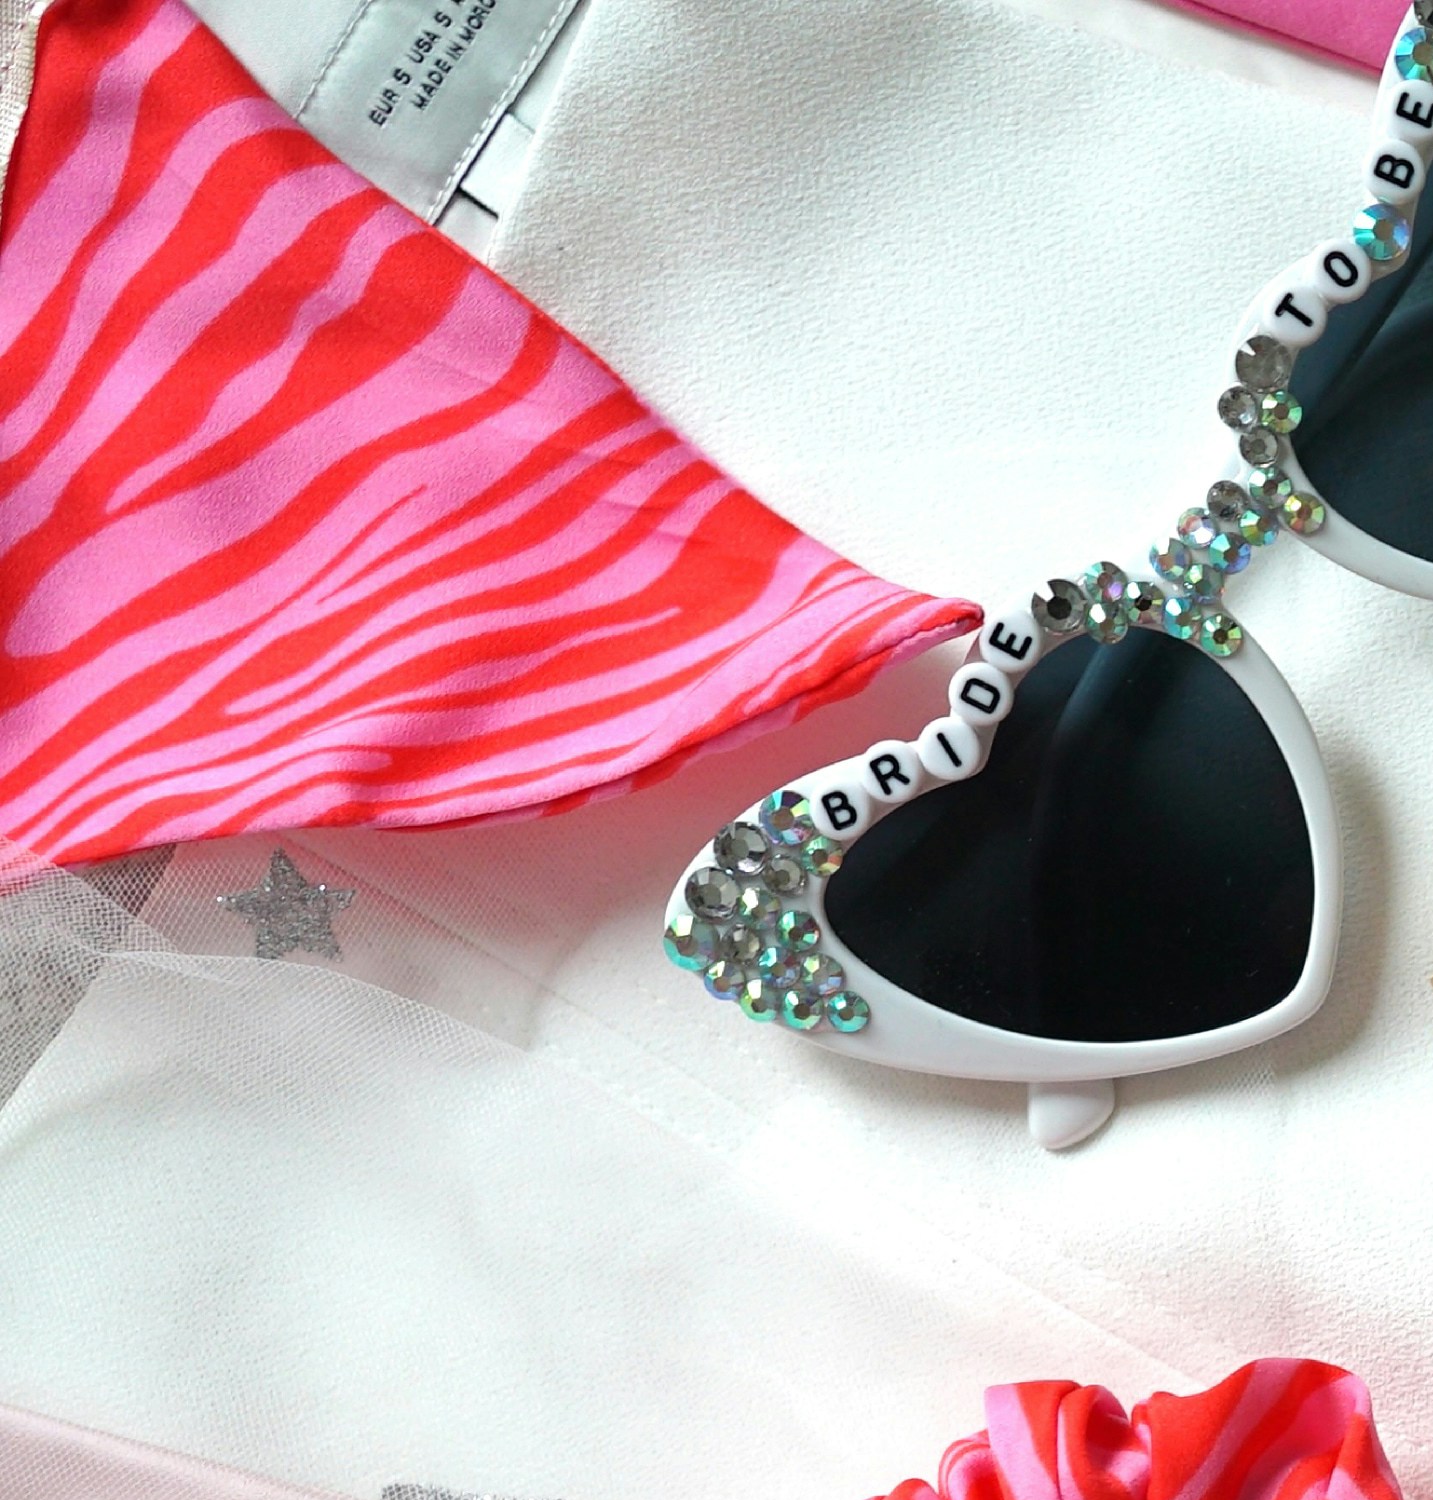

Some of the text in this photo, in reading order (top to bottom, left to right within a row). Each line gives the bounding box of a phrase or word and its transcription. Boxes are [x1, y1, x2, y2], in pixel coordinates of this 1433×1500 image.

[368, 10, 452, 126] EUR S USA S
[411, 58, 454, 111] MADE
[445, 40, 467, 61] IN
[821, 622, 1032, 830] BRIDE
[1275, 251, 1358, 327] TO
